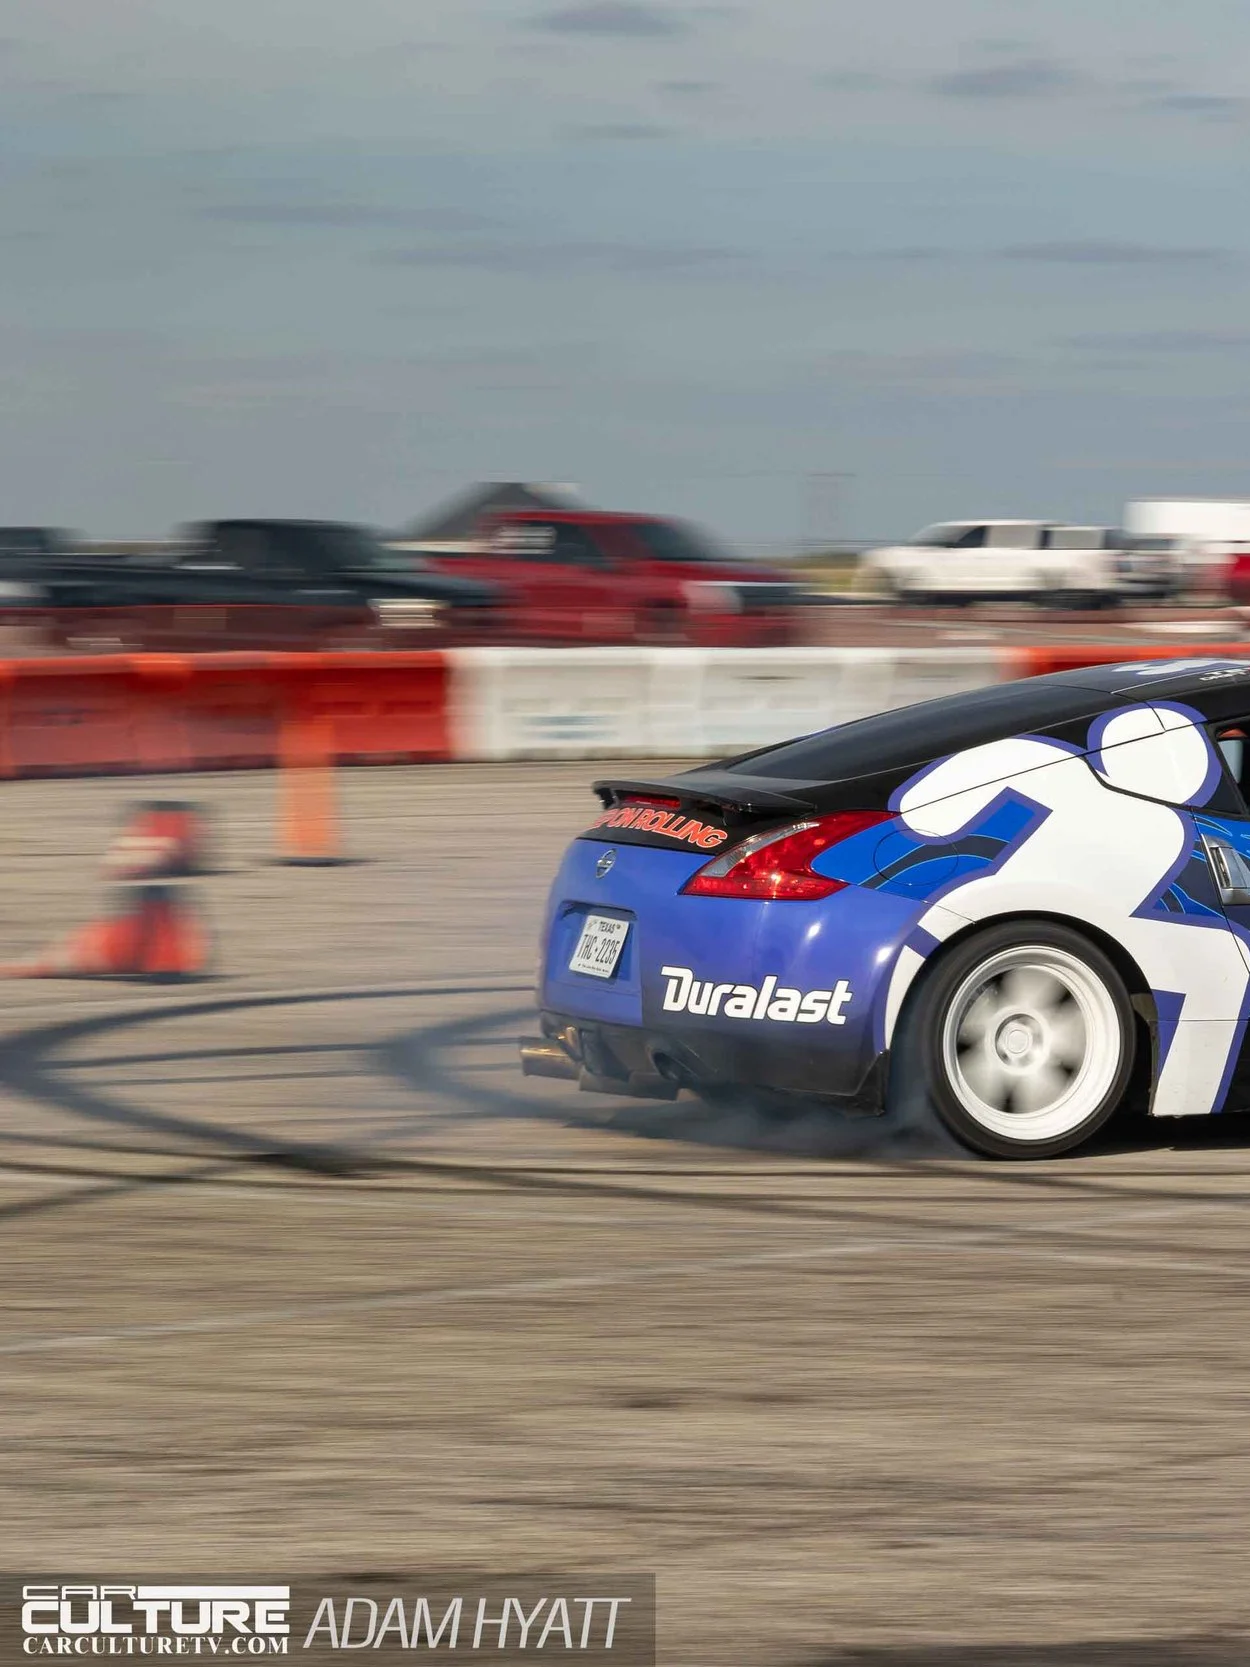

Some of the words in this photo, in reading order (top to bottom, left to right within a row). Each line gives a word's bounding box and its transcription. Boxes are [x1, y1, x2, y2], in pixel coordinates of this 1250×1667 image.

[628, 808, 728, 848] ROLLING
[599, 921, 616, 934] TEXAS
[660, 965, 853, 1026] Duralast
